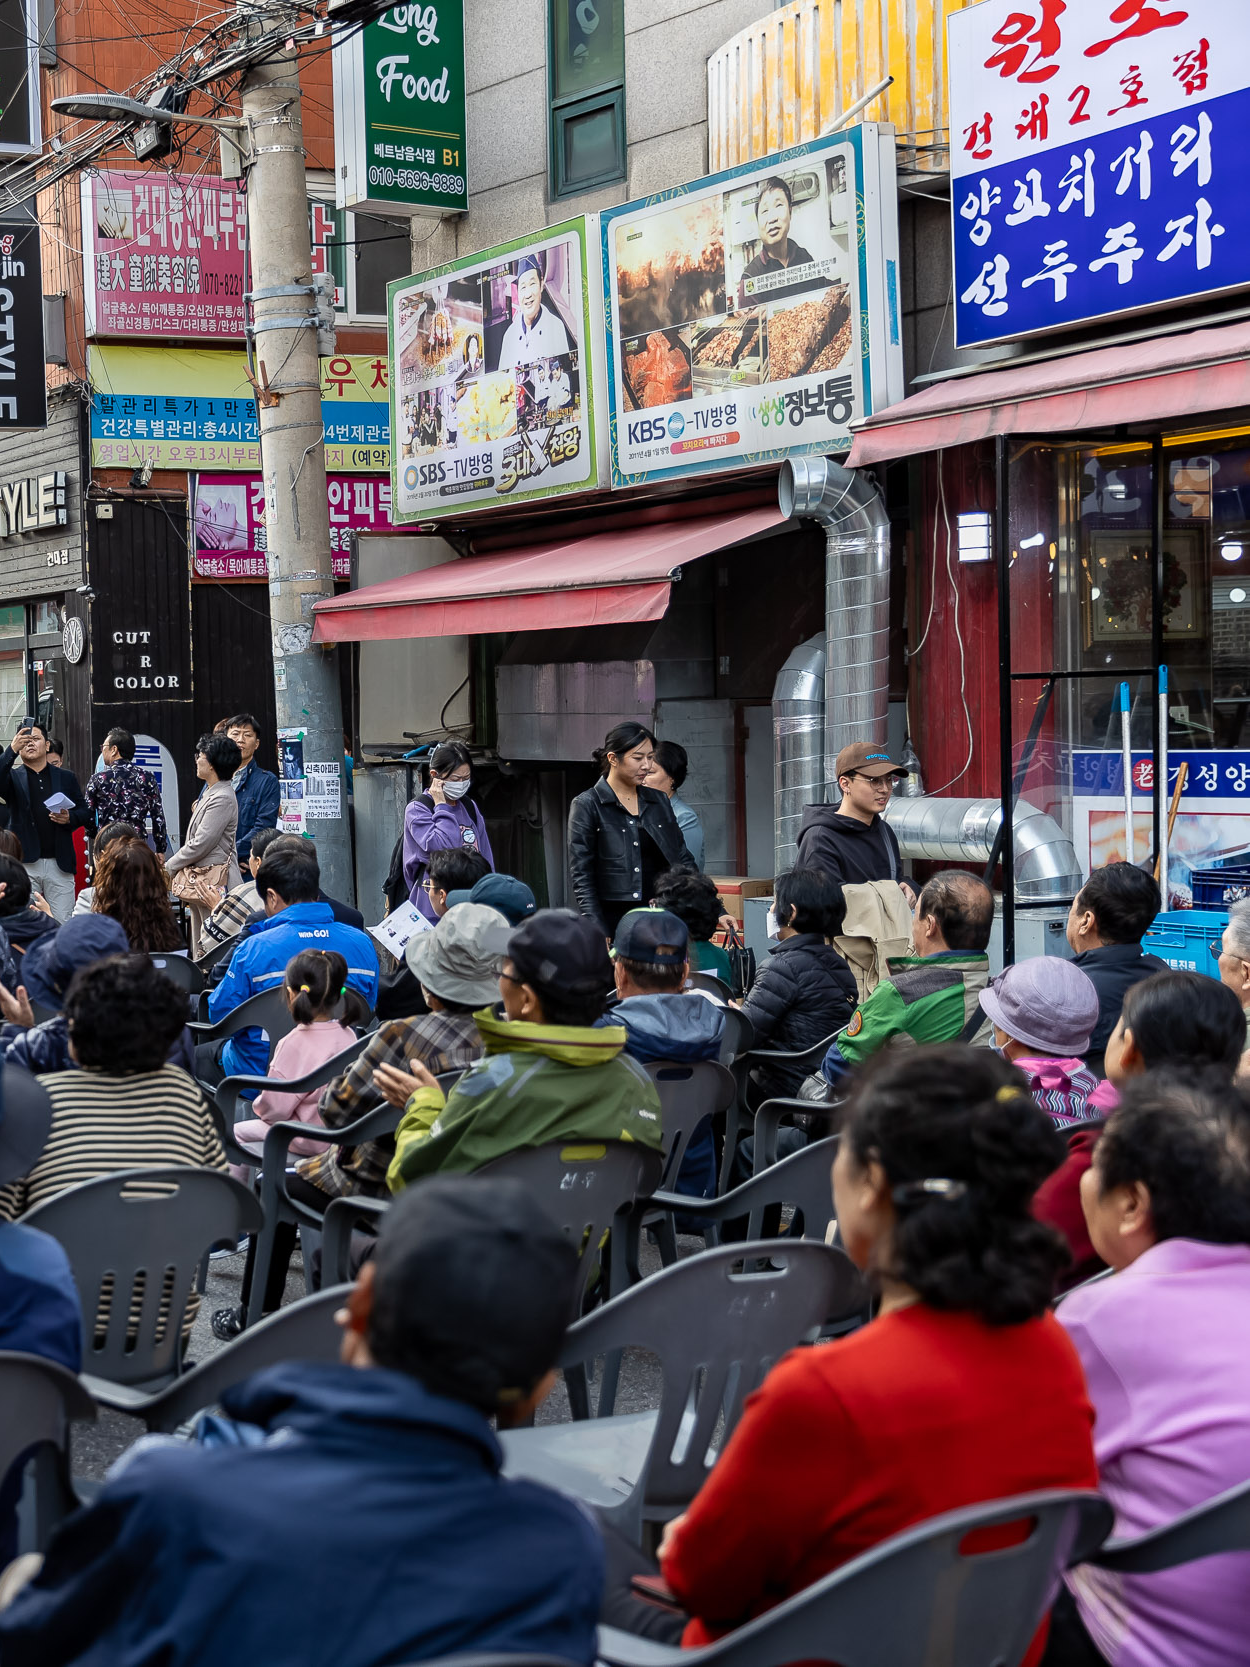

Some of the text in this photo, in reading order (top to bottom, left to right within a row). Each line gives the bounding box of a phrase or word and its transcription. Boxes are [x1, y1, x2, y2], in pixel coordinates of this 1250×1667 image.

[376, 55, 450, 104] Food
[374, 143, 460, 167] 베트남음식점 B1
[369, 166, 464, 195] 010-5696-9889
[960, 111, 1212, 247] 양꼬치거리
[961, 197, 1225, 317] 선두주자
[628, 416, 666, 446] KBS
[112, 631, 151, 645] CUT
[114, 675, 180, 689] COLOR
[298, 929, 330, 939] With GO!
